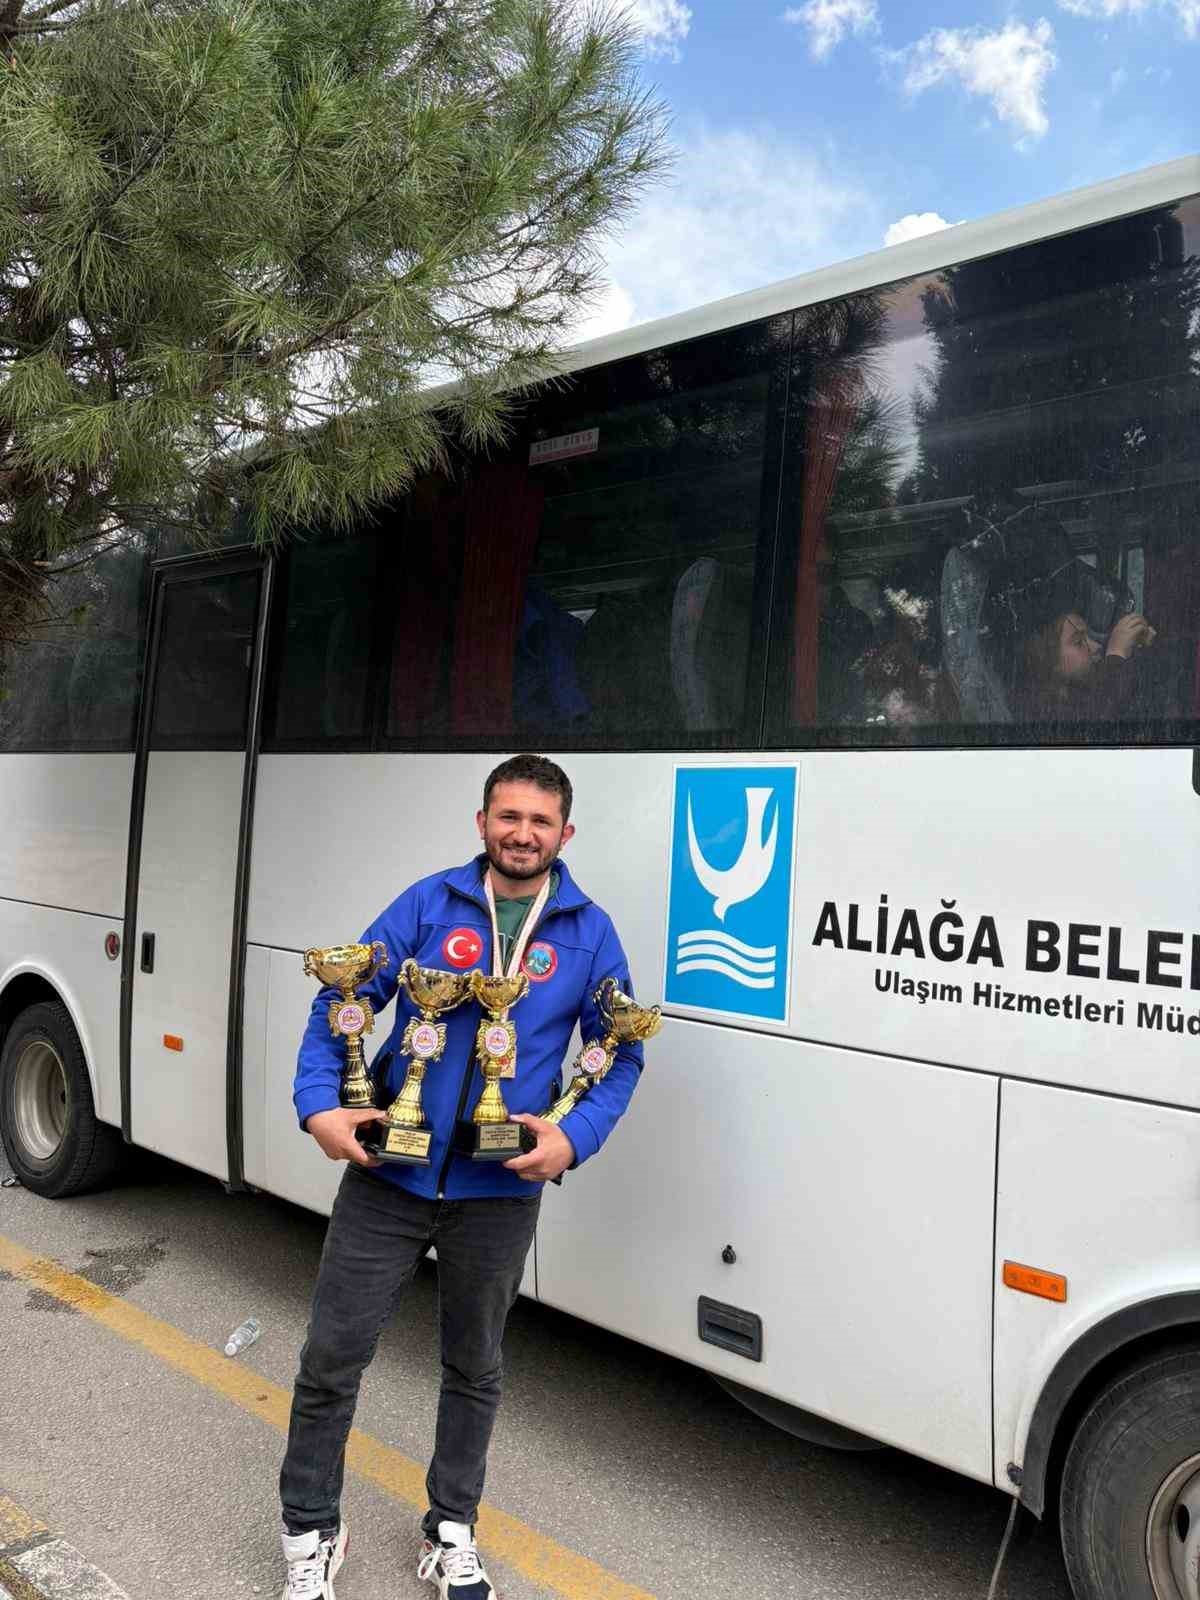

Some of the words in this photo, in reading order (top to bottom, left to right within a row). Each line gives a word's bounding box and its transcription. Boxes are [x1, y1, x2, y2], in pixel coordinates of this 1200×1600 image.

[811, 893, 1005, 969] ALİAĞA
[874, 968, 963, 1005] Ulaşım
[973, 981, 1125, 1026] Hizmetleri
